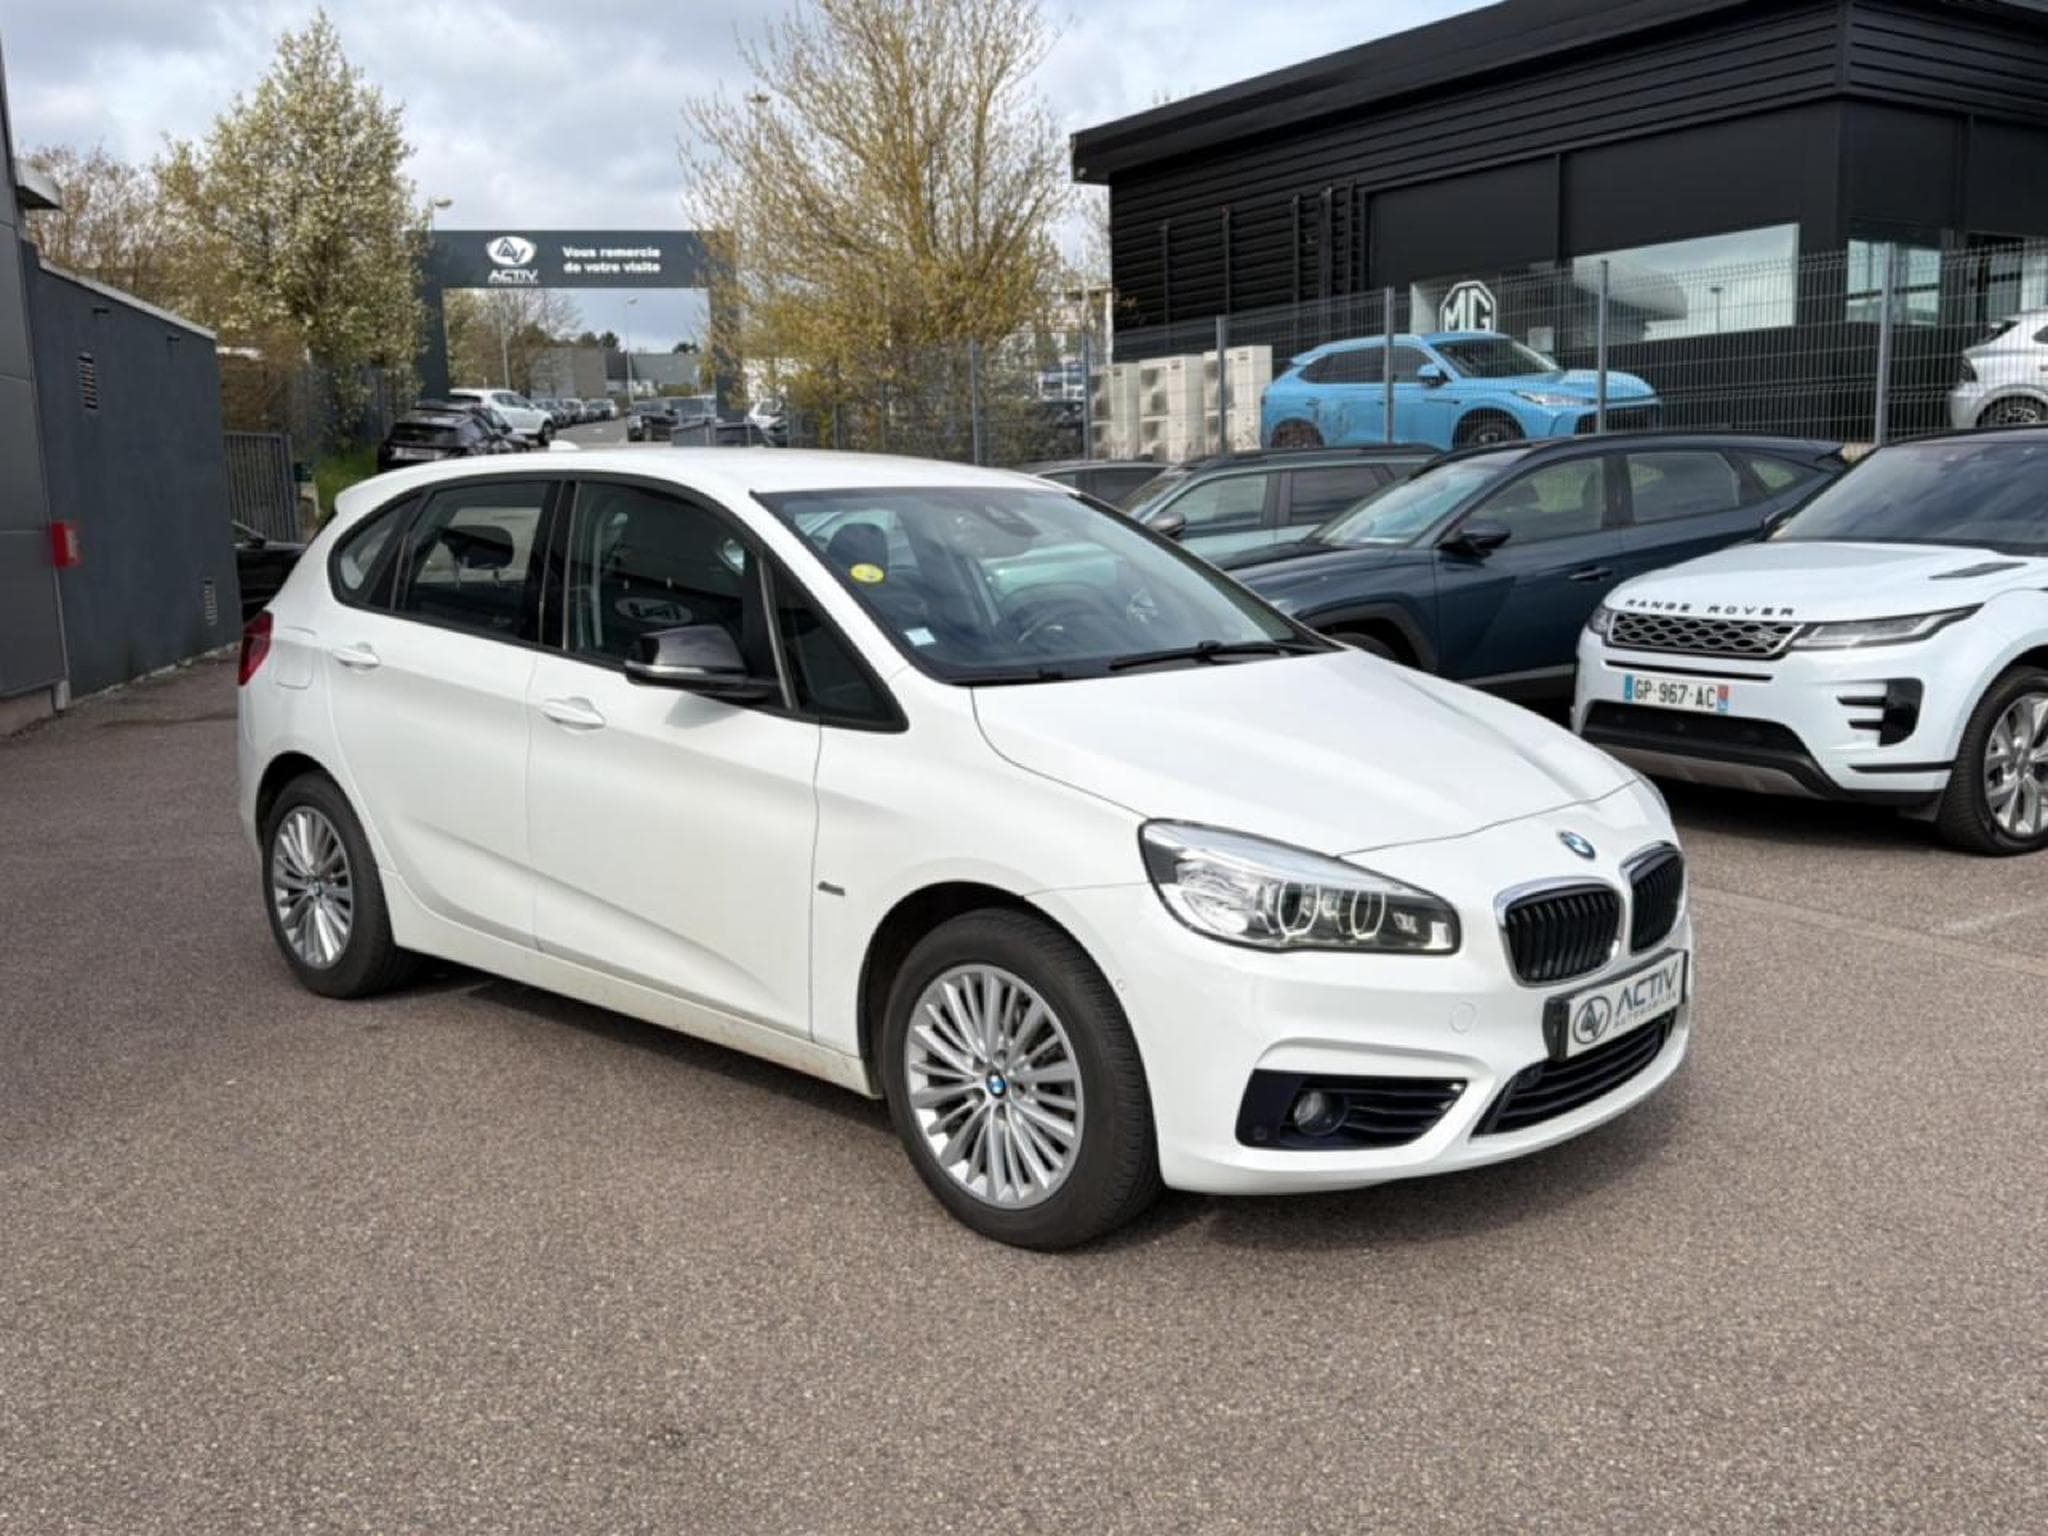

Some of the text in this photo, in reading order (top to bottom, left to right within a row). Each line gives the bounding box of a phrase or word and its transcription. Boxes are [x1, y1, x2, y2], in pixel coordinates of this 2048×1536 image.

[562, 246, 661, 258] Vous remercie
[563, 261, 661, 273] de votre visite
[488, 269, 538, 283] ACTIV
[1444, 287, 1491, 333] MG
[1625, 599, 1795, 616] RANGE ROVER
[1616, 961, 1678, 1017] ACTIV
